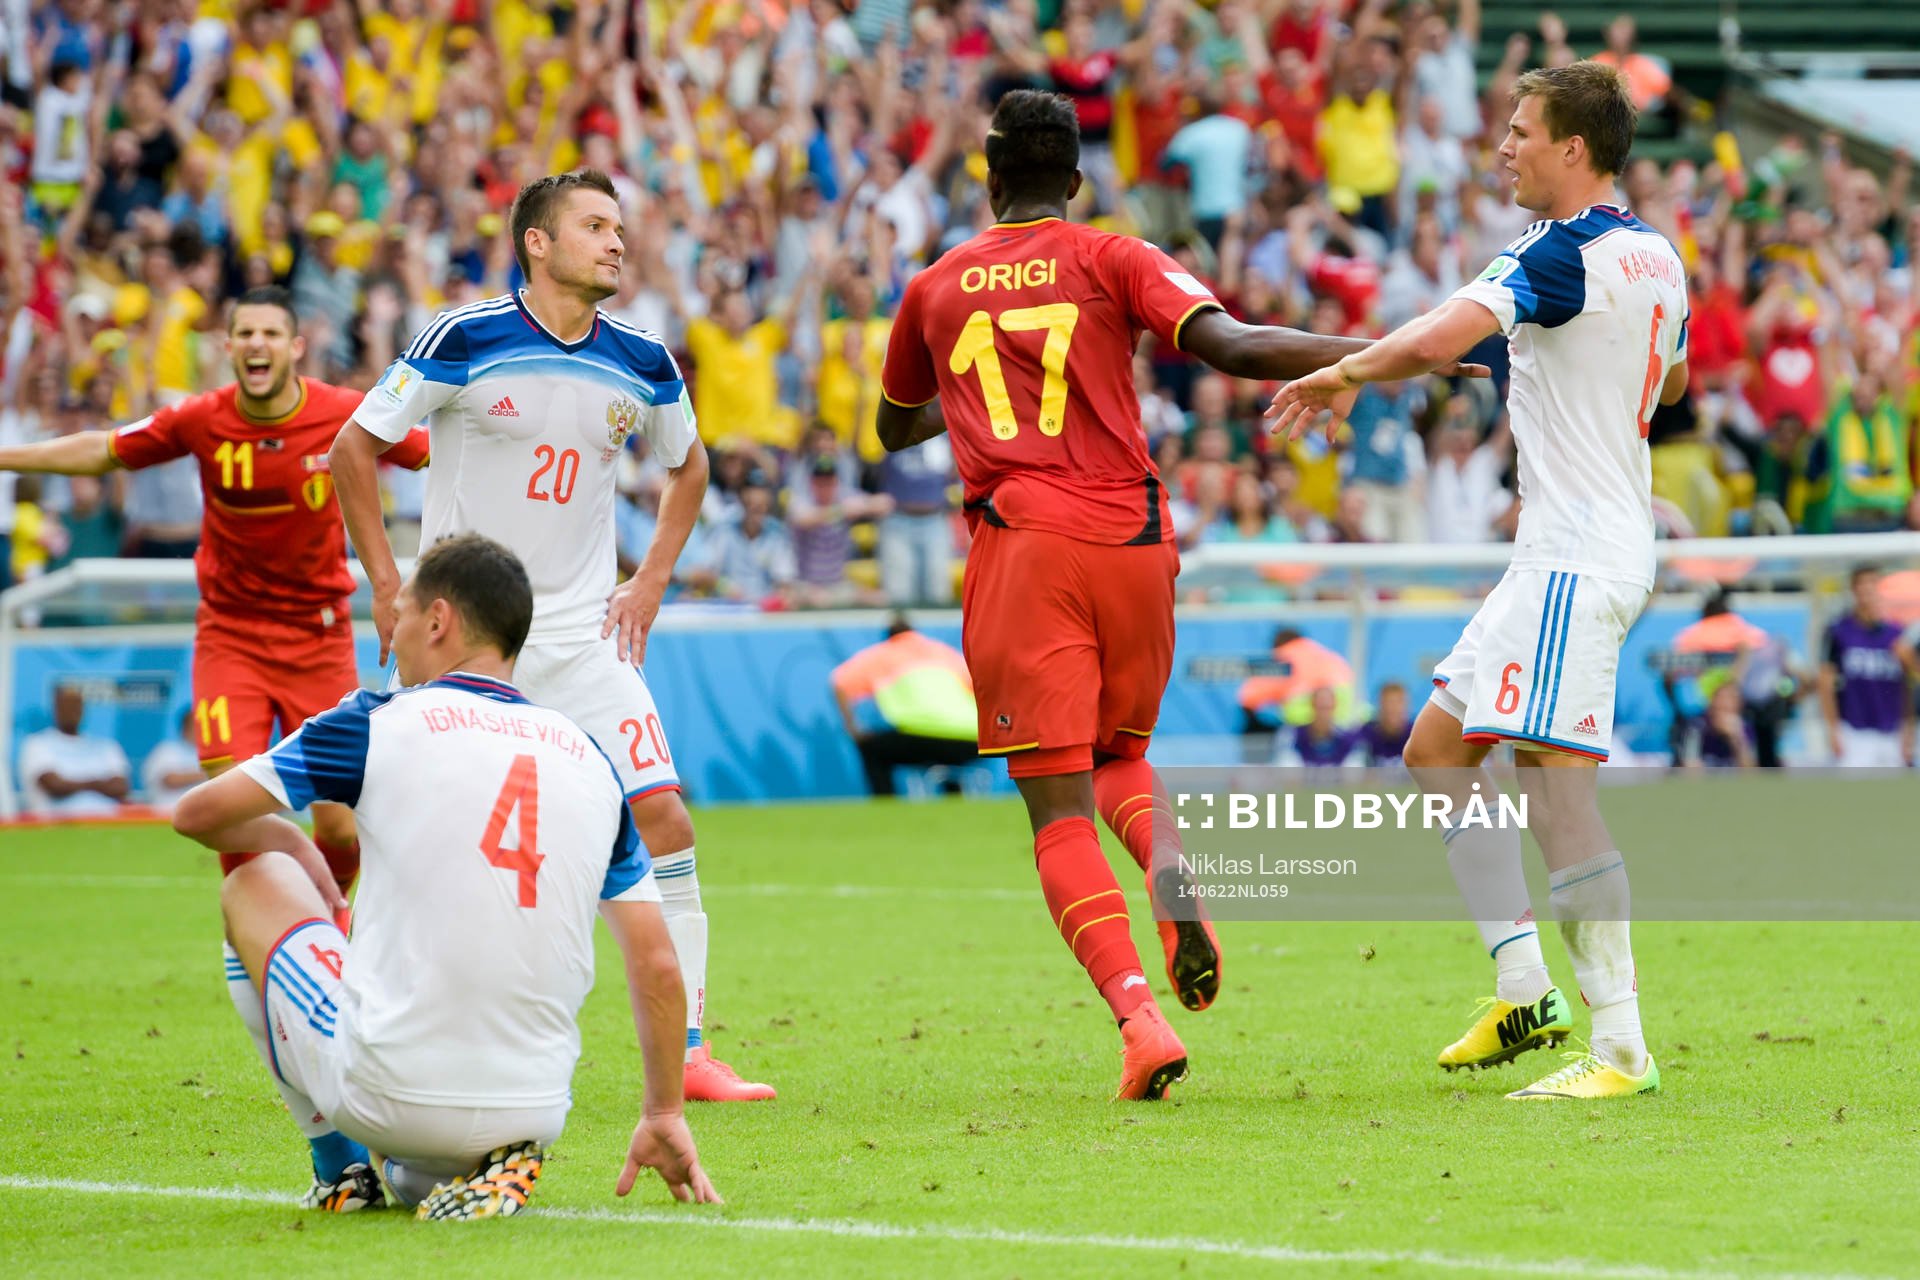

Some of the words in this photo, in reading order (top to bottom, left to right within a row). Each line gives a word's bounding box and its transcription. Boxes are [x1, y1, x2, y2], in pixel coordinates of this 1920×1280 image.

[960, 258, 1056, 293] ORIGI
[949, 302, 1079, 441] 17
[1637, 303, 1664, 439] 6
[487, 408, 520, 417] adidas
[214, 440, 253, 490] 11
[527, 444, 580, 504] 20
[1495, 662, 1522, 714] 6
[196, 695, 232, 746] 11
[421, 705, 585, 761] IGNASHEVICH
[619, 712, 670, 771] 20
[1573, 724, 1599, 736] adidas
[479, 754, 546, 908] 4
[1496, 988, 1558, 1048] NIKE
